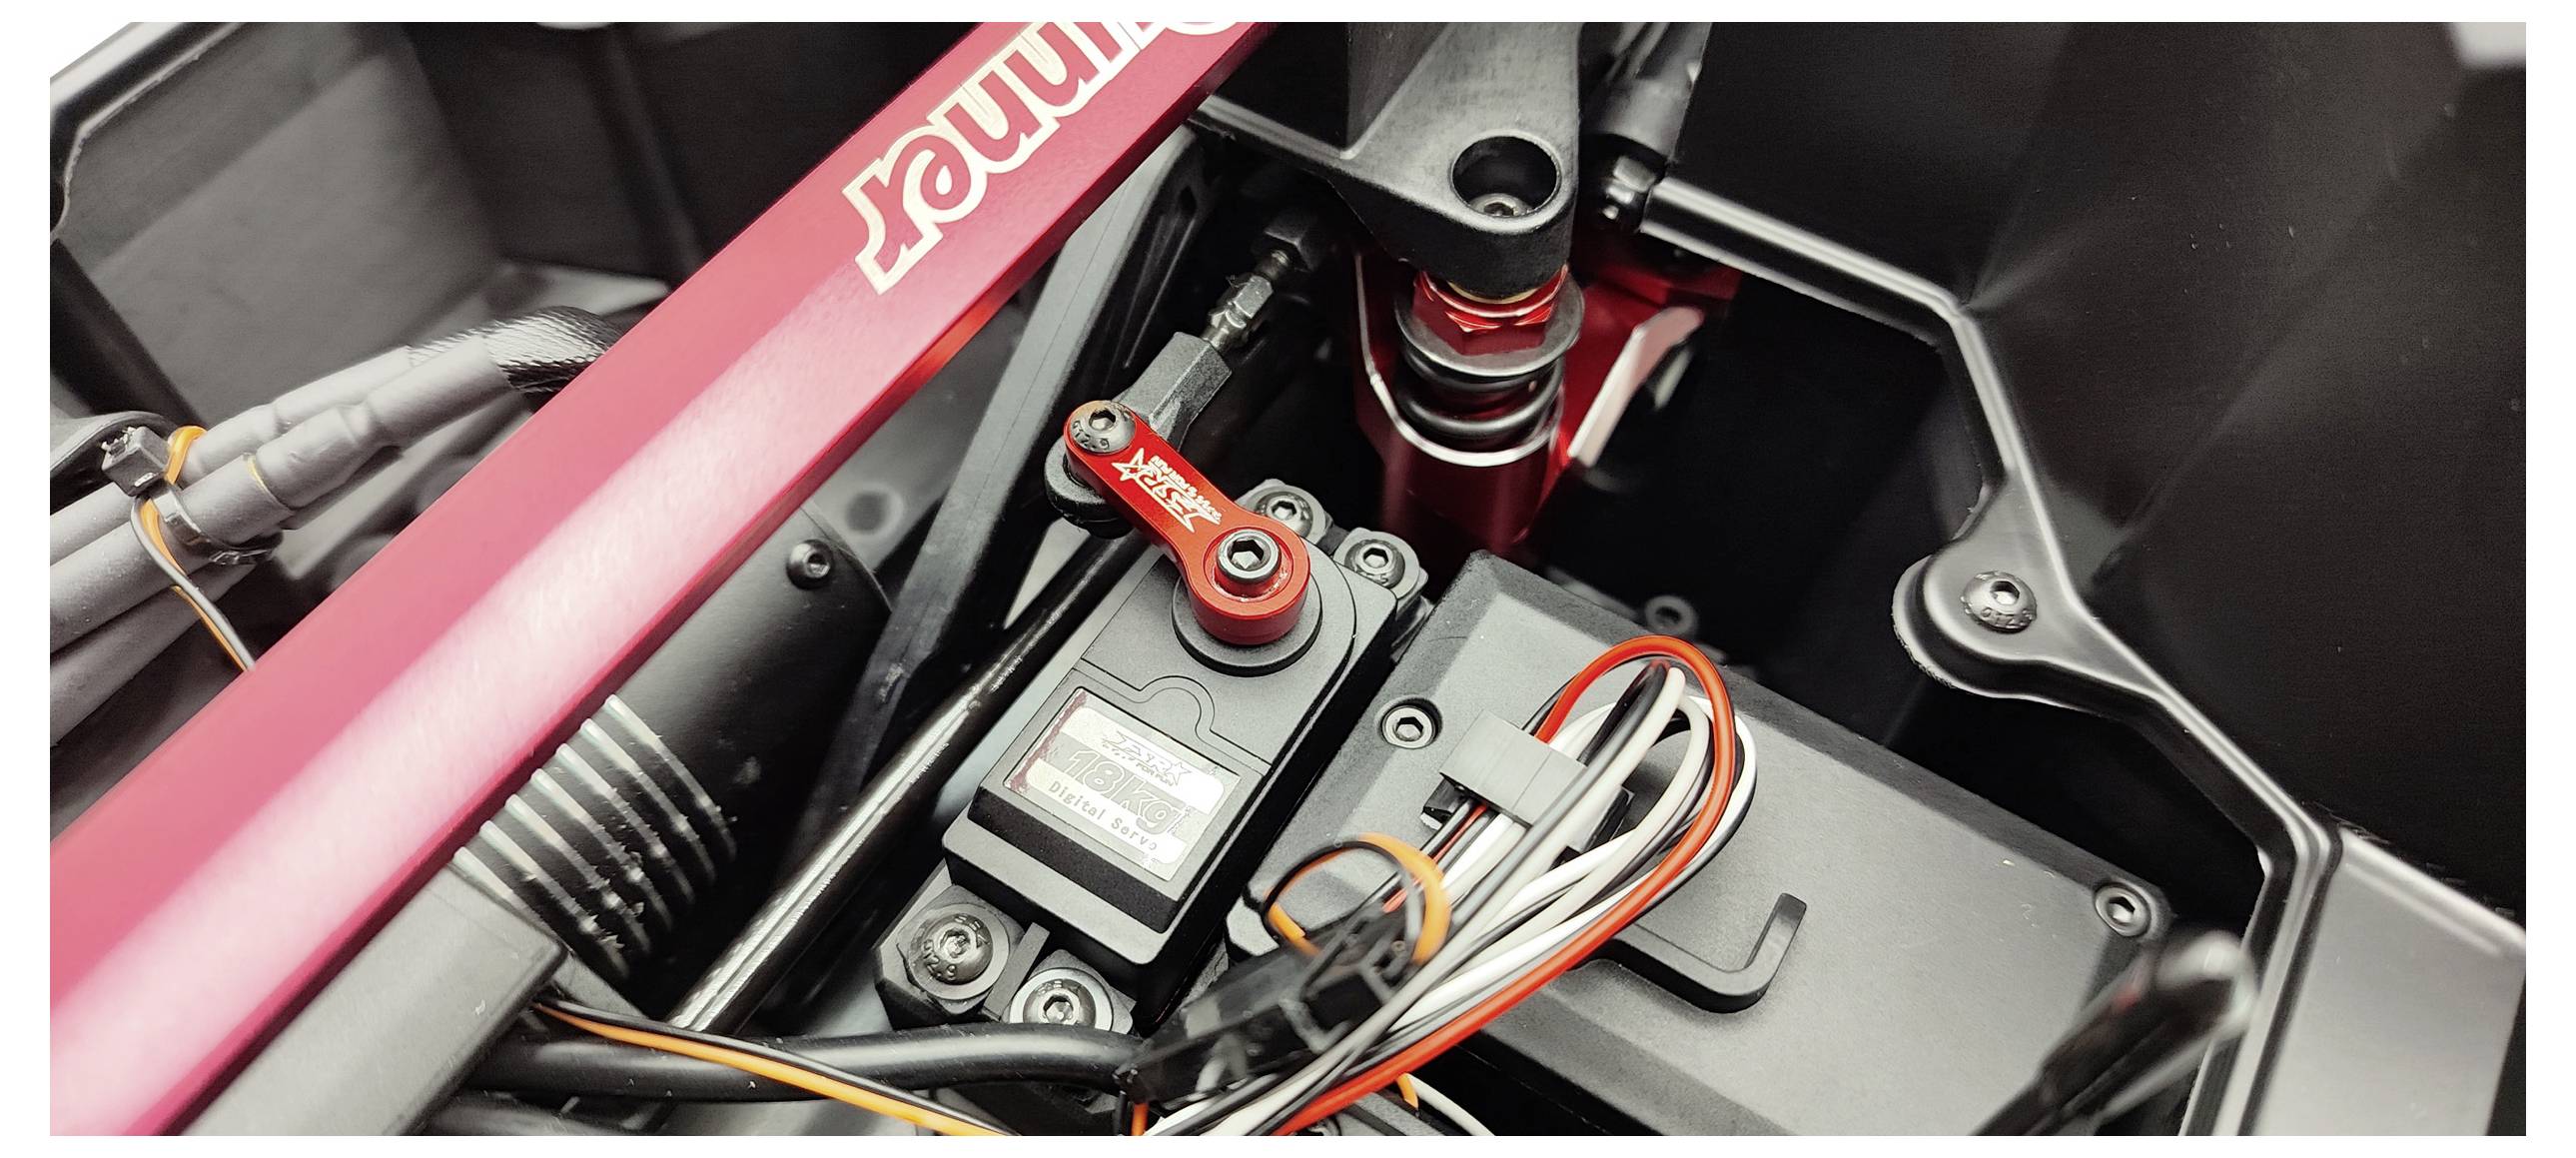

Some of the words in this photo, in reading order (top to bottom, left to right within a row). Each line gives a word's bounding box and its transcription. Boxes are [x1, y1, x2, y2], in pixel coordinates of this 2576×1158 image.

[1049, 780, 1107, 821] Digital
[1111, 817, 1159, 851] Servo
[1061, 749, 1182, 835] 18kg
